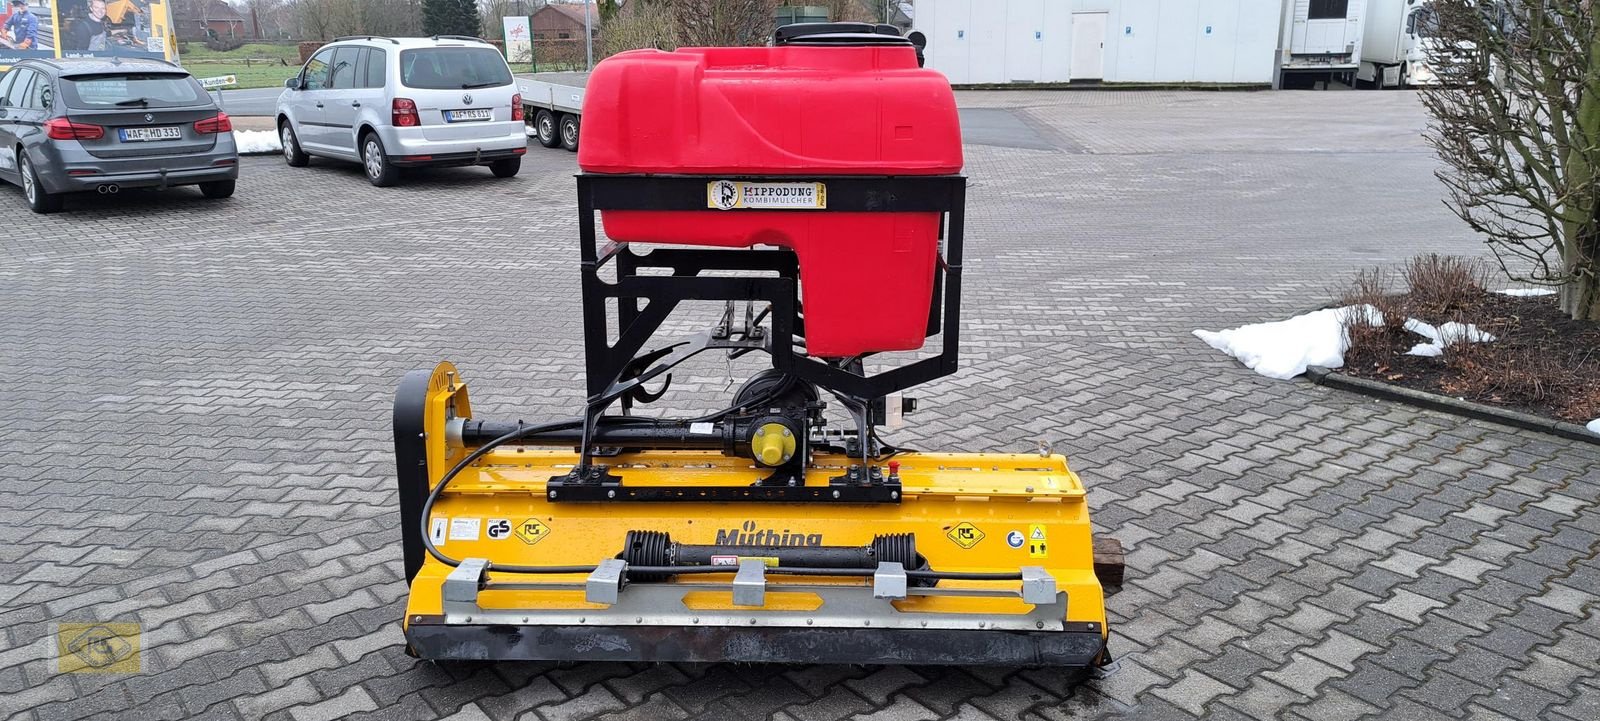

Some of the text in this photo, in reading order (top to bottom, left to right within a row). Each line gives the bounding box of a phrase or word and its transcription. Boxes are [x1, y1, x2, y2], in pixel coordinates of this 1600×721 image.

[126, 129, 143, 139] WAF
[163, 127, 180, 137] 333
[488, 520, 510, 537] GS
